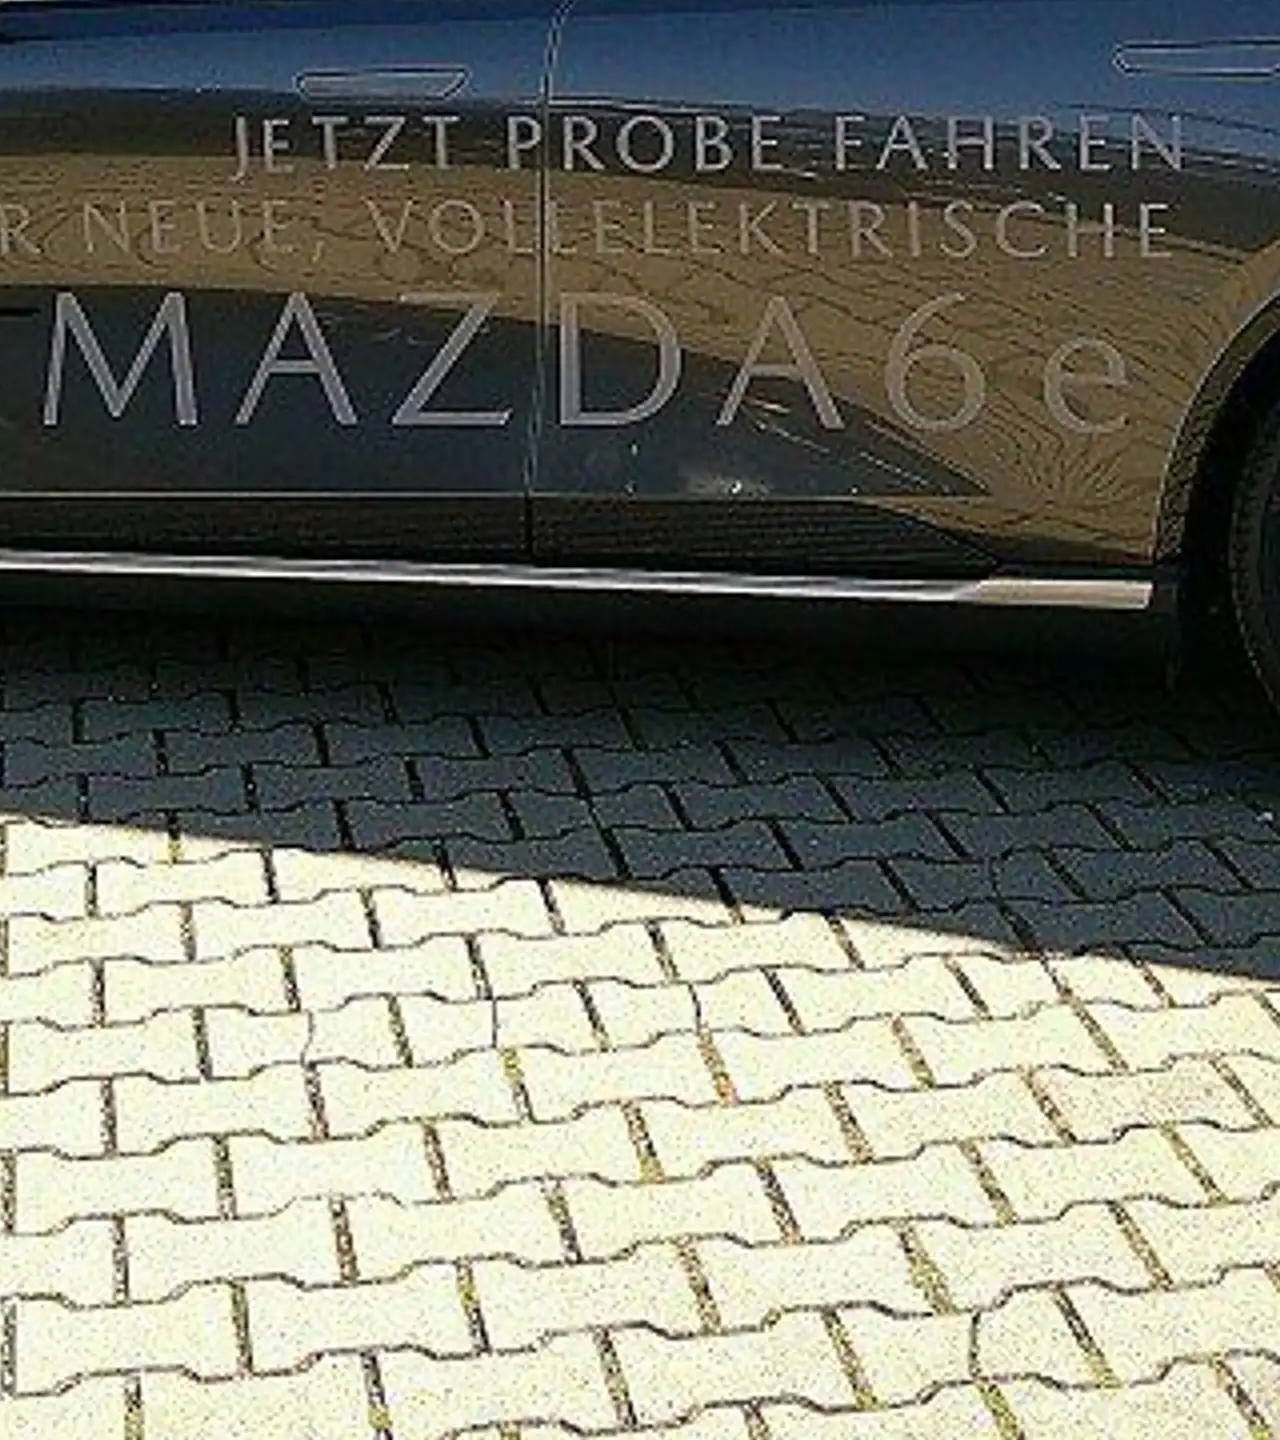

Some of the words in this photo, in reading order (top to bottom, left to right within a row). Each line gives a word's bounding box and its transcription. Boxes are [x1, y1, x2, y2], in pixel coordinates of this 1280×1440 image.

[229, 114, 461, 182] JETZT
[505, 114, 784, 173] PROBE
[834, 114, 1184, 172] FAHREN
[82, 198, 323, 264] NEUE,
[360, 198, 1173, 259] VOLLELEKTRISCHE
[43, 291, 1129, 434] MAZDA6e
